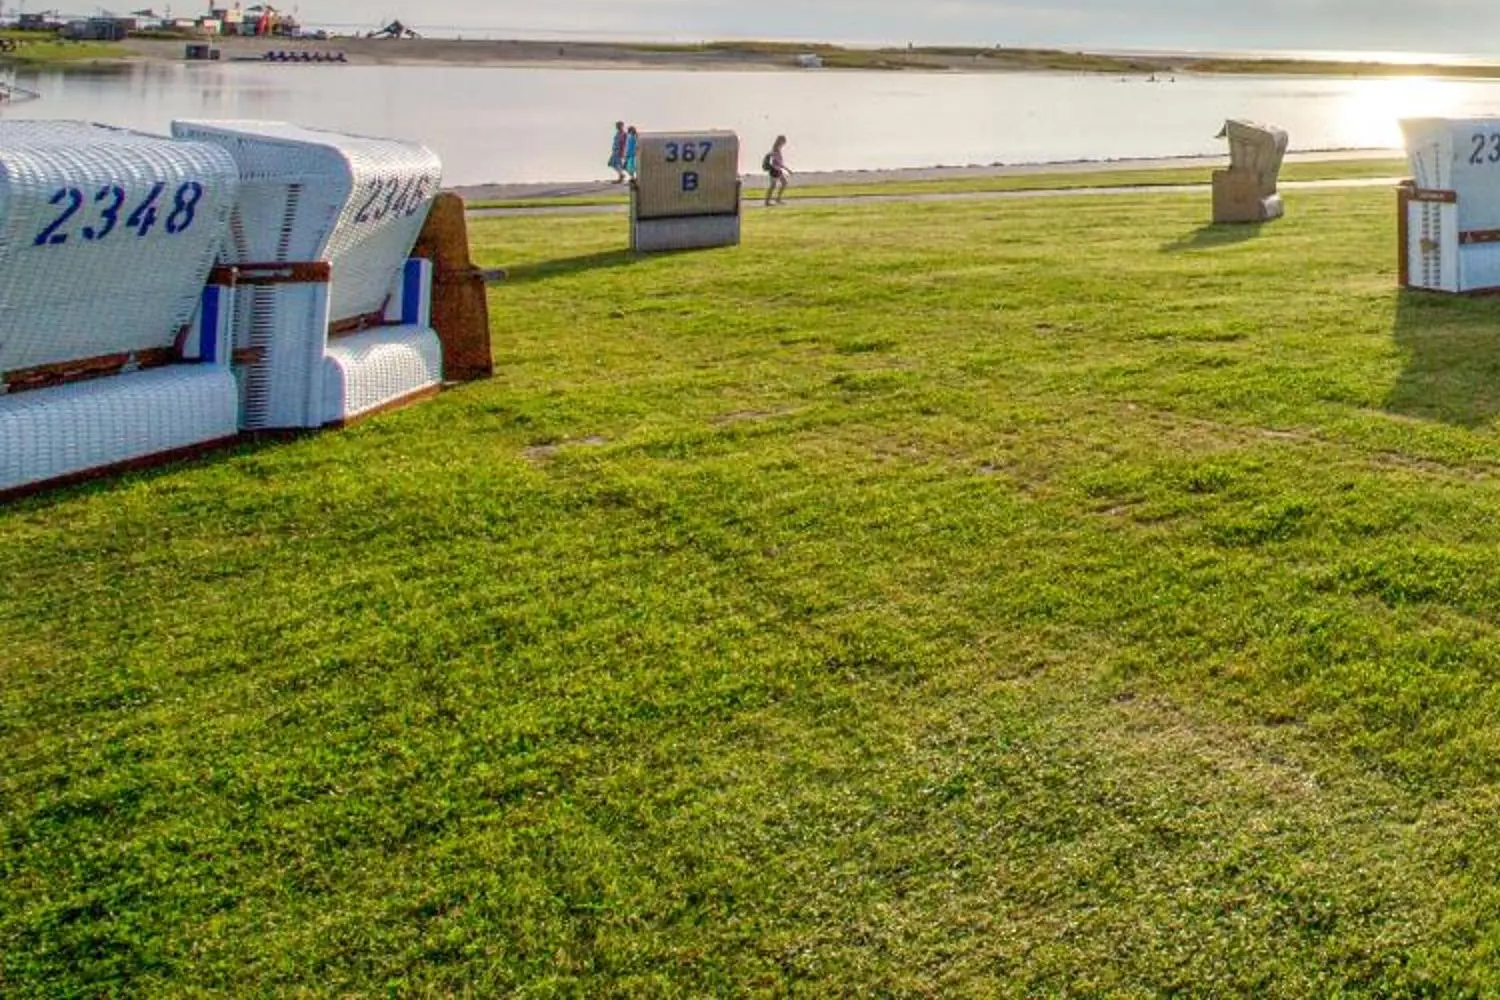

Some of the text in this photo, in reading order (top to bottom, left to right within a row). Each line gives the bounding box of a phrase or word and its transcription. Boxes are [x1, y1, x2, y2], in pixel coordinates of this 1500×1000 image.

[665, 141, 713, 163] 367
[681, 171, 699, 192] B
[33, 181, 204, 246] 2348
